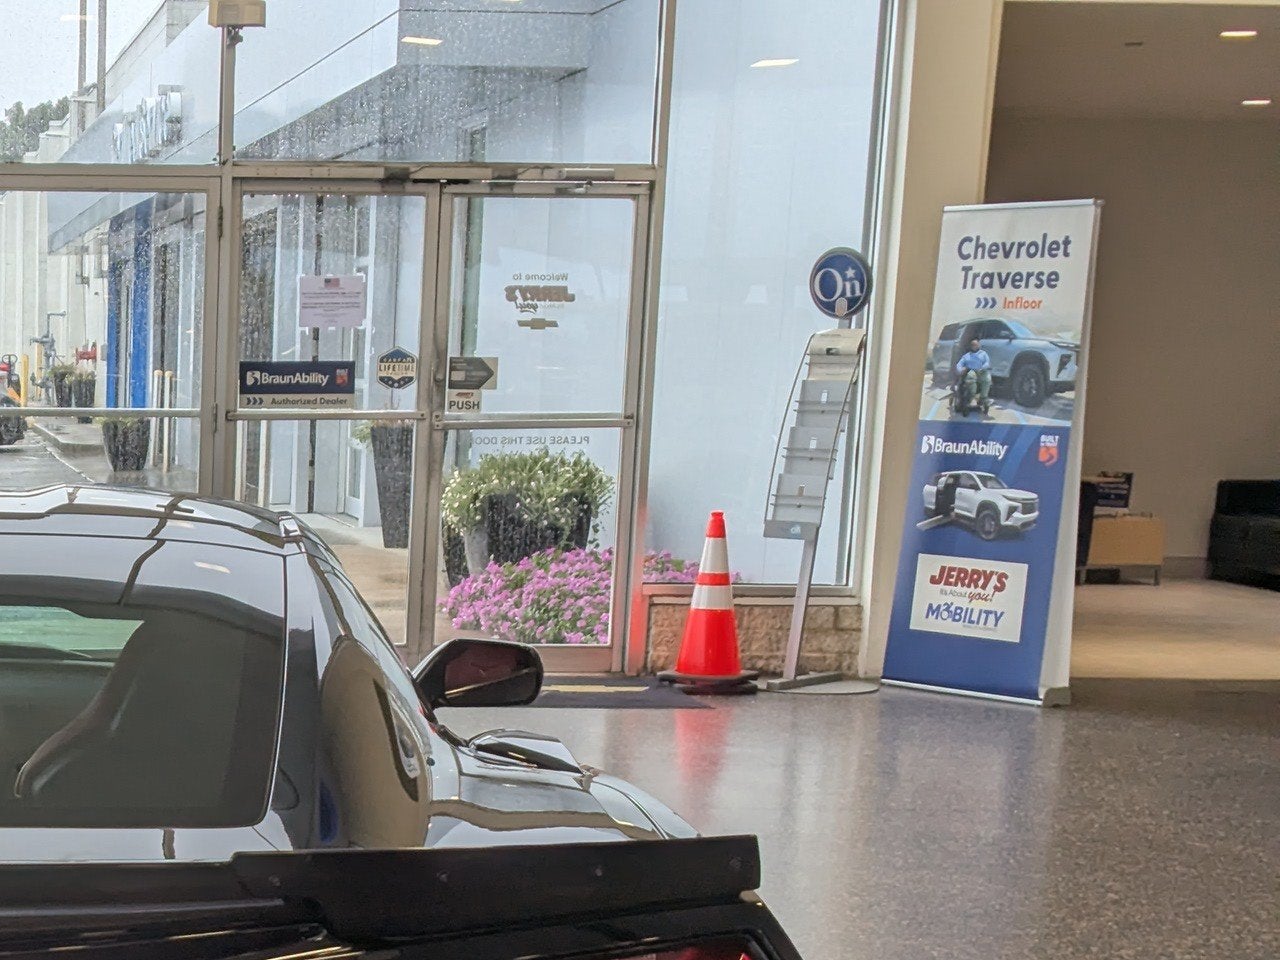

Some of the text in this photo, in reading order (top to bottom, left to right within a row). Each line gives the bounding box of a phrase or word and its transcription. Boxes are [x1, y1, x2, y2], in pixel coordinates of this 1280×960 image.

[957, 233, 1072, 260] Chevrolet
[814, 267, 862, 301] On
[961, 266, 1060, 290] Traverse
[1003, 297, 1043, 309] Infloor
[261, 372, 330, 386] BraunAbility
[270, 397, 348, 405] Authorized Dealer
[449, 401, 480, 410] PUSH
[934, 438, 1009, 459] BraunAbility
[929, 566, 1009, 592] JERRY'S
[967, 591, 996, 603] you!
